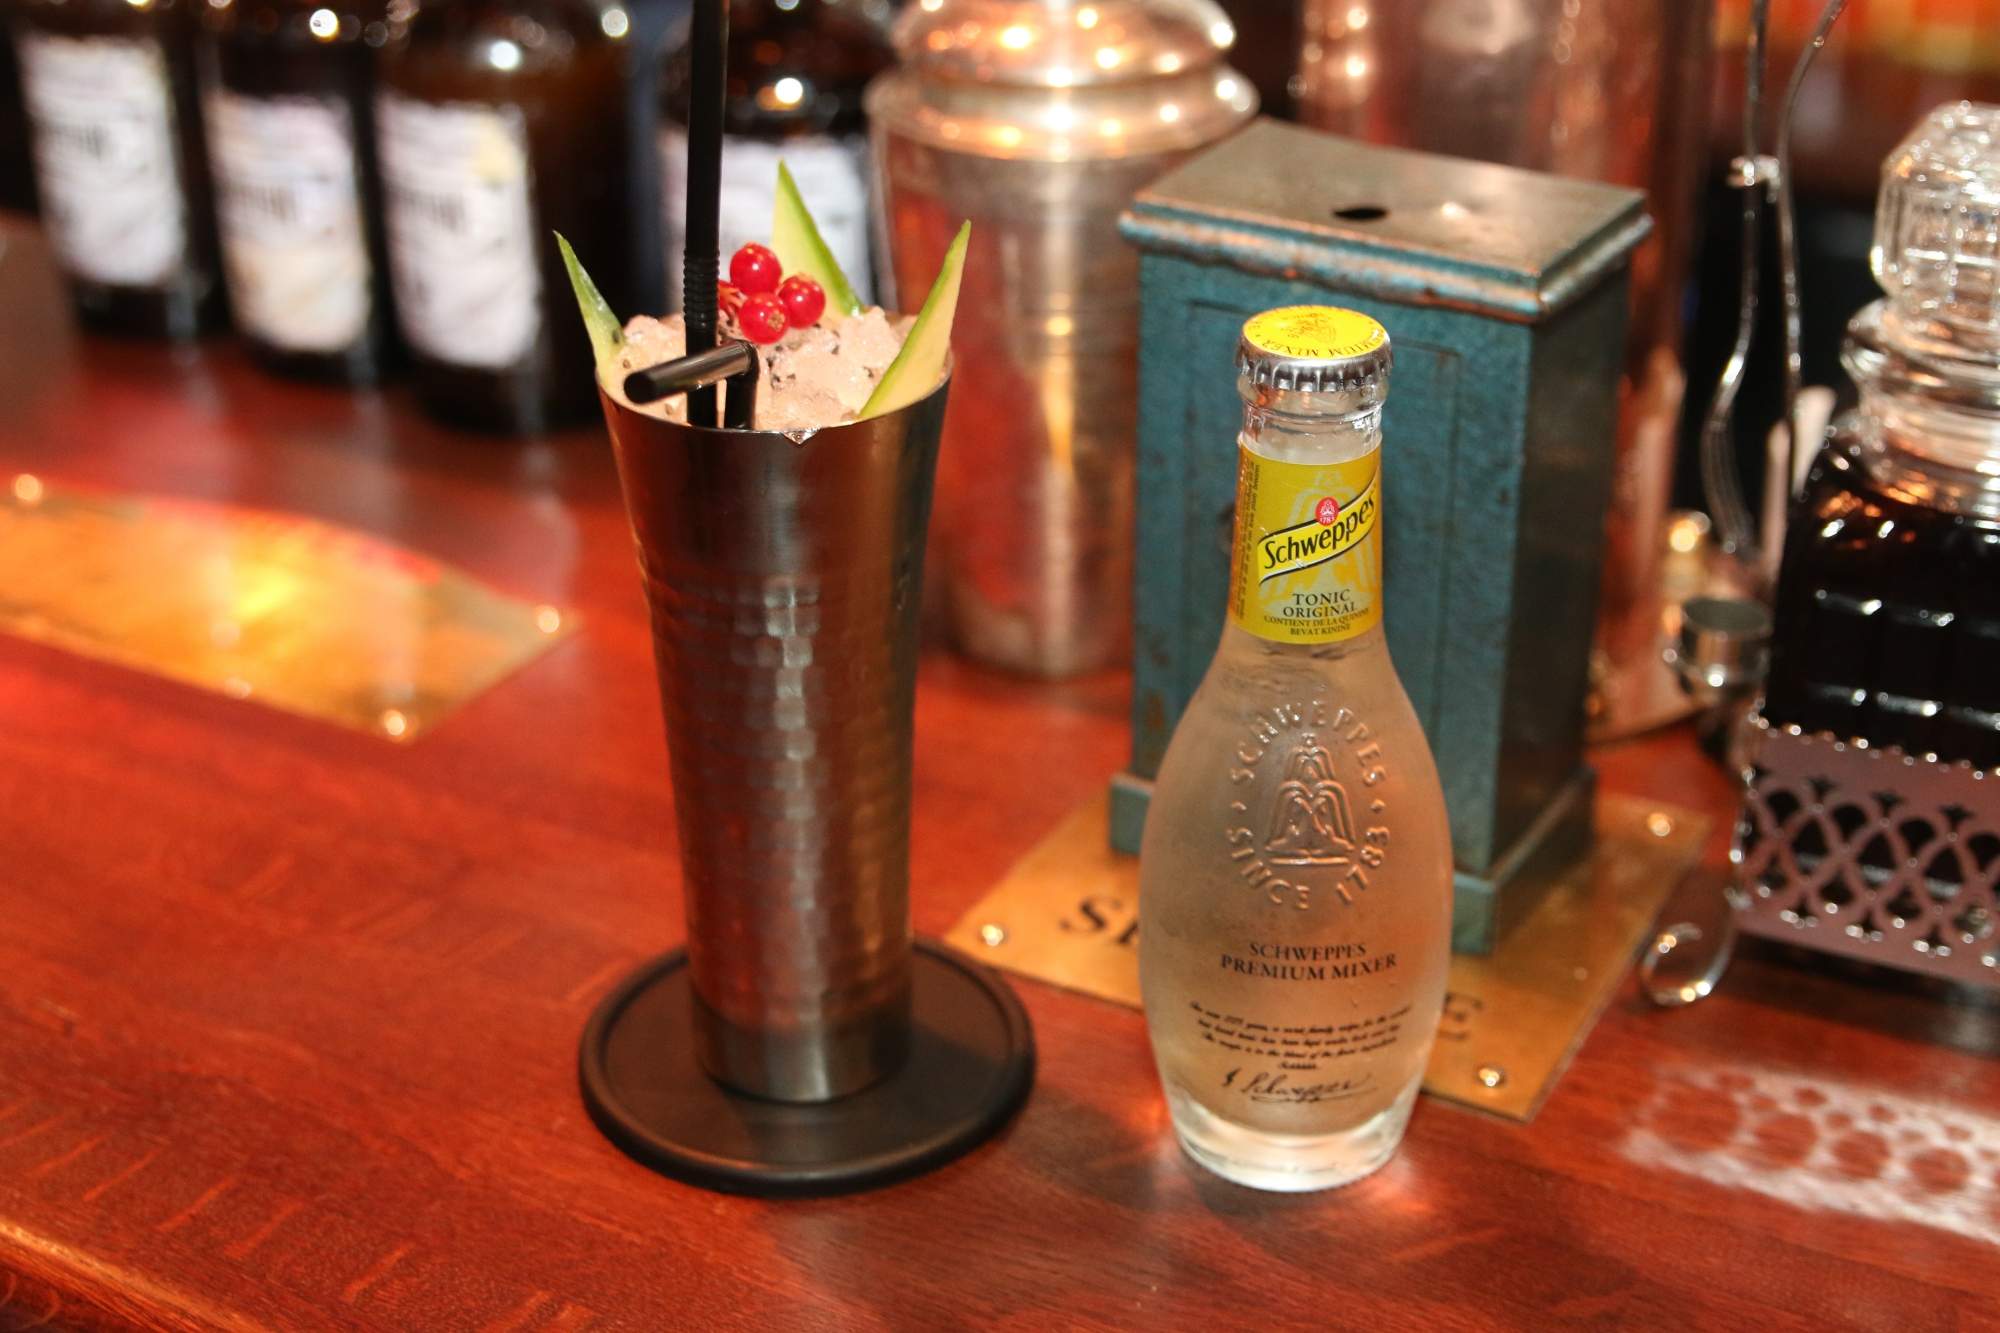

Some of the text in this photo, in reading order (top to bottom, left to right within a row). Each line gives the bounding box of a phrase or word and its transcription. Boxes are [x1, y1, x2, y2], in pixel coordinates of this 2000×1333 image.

[1262, 339, 1319, 357] MIXER
[1264, 491, 1375, 570] Schweppes
[1292, 589, 1351, 606] TONIC
[1282, 602, 1356, 618] ORIGINAL
[1264, 616, 1310, 627] CONTIENT
[1312, 619, 1325, 627] DE
[1326, 618, 1339, 626] LA
[1290, 626, 1321, 636] BEVAT
[1230, 698, 1387, 784] SCHWEPPES
[1227, 826, 1391, 910] SINCE 1783
[1250, 943, 1367, 961] SCHWEPPES
[1220, 953, 1397, 981] PREMIUM MIXER
